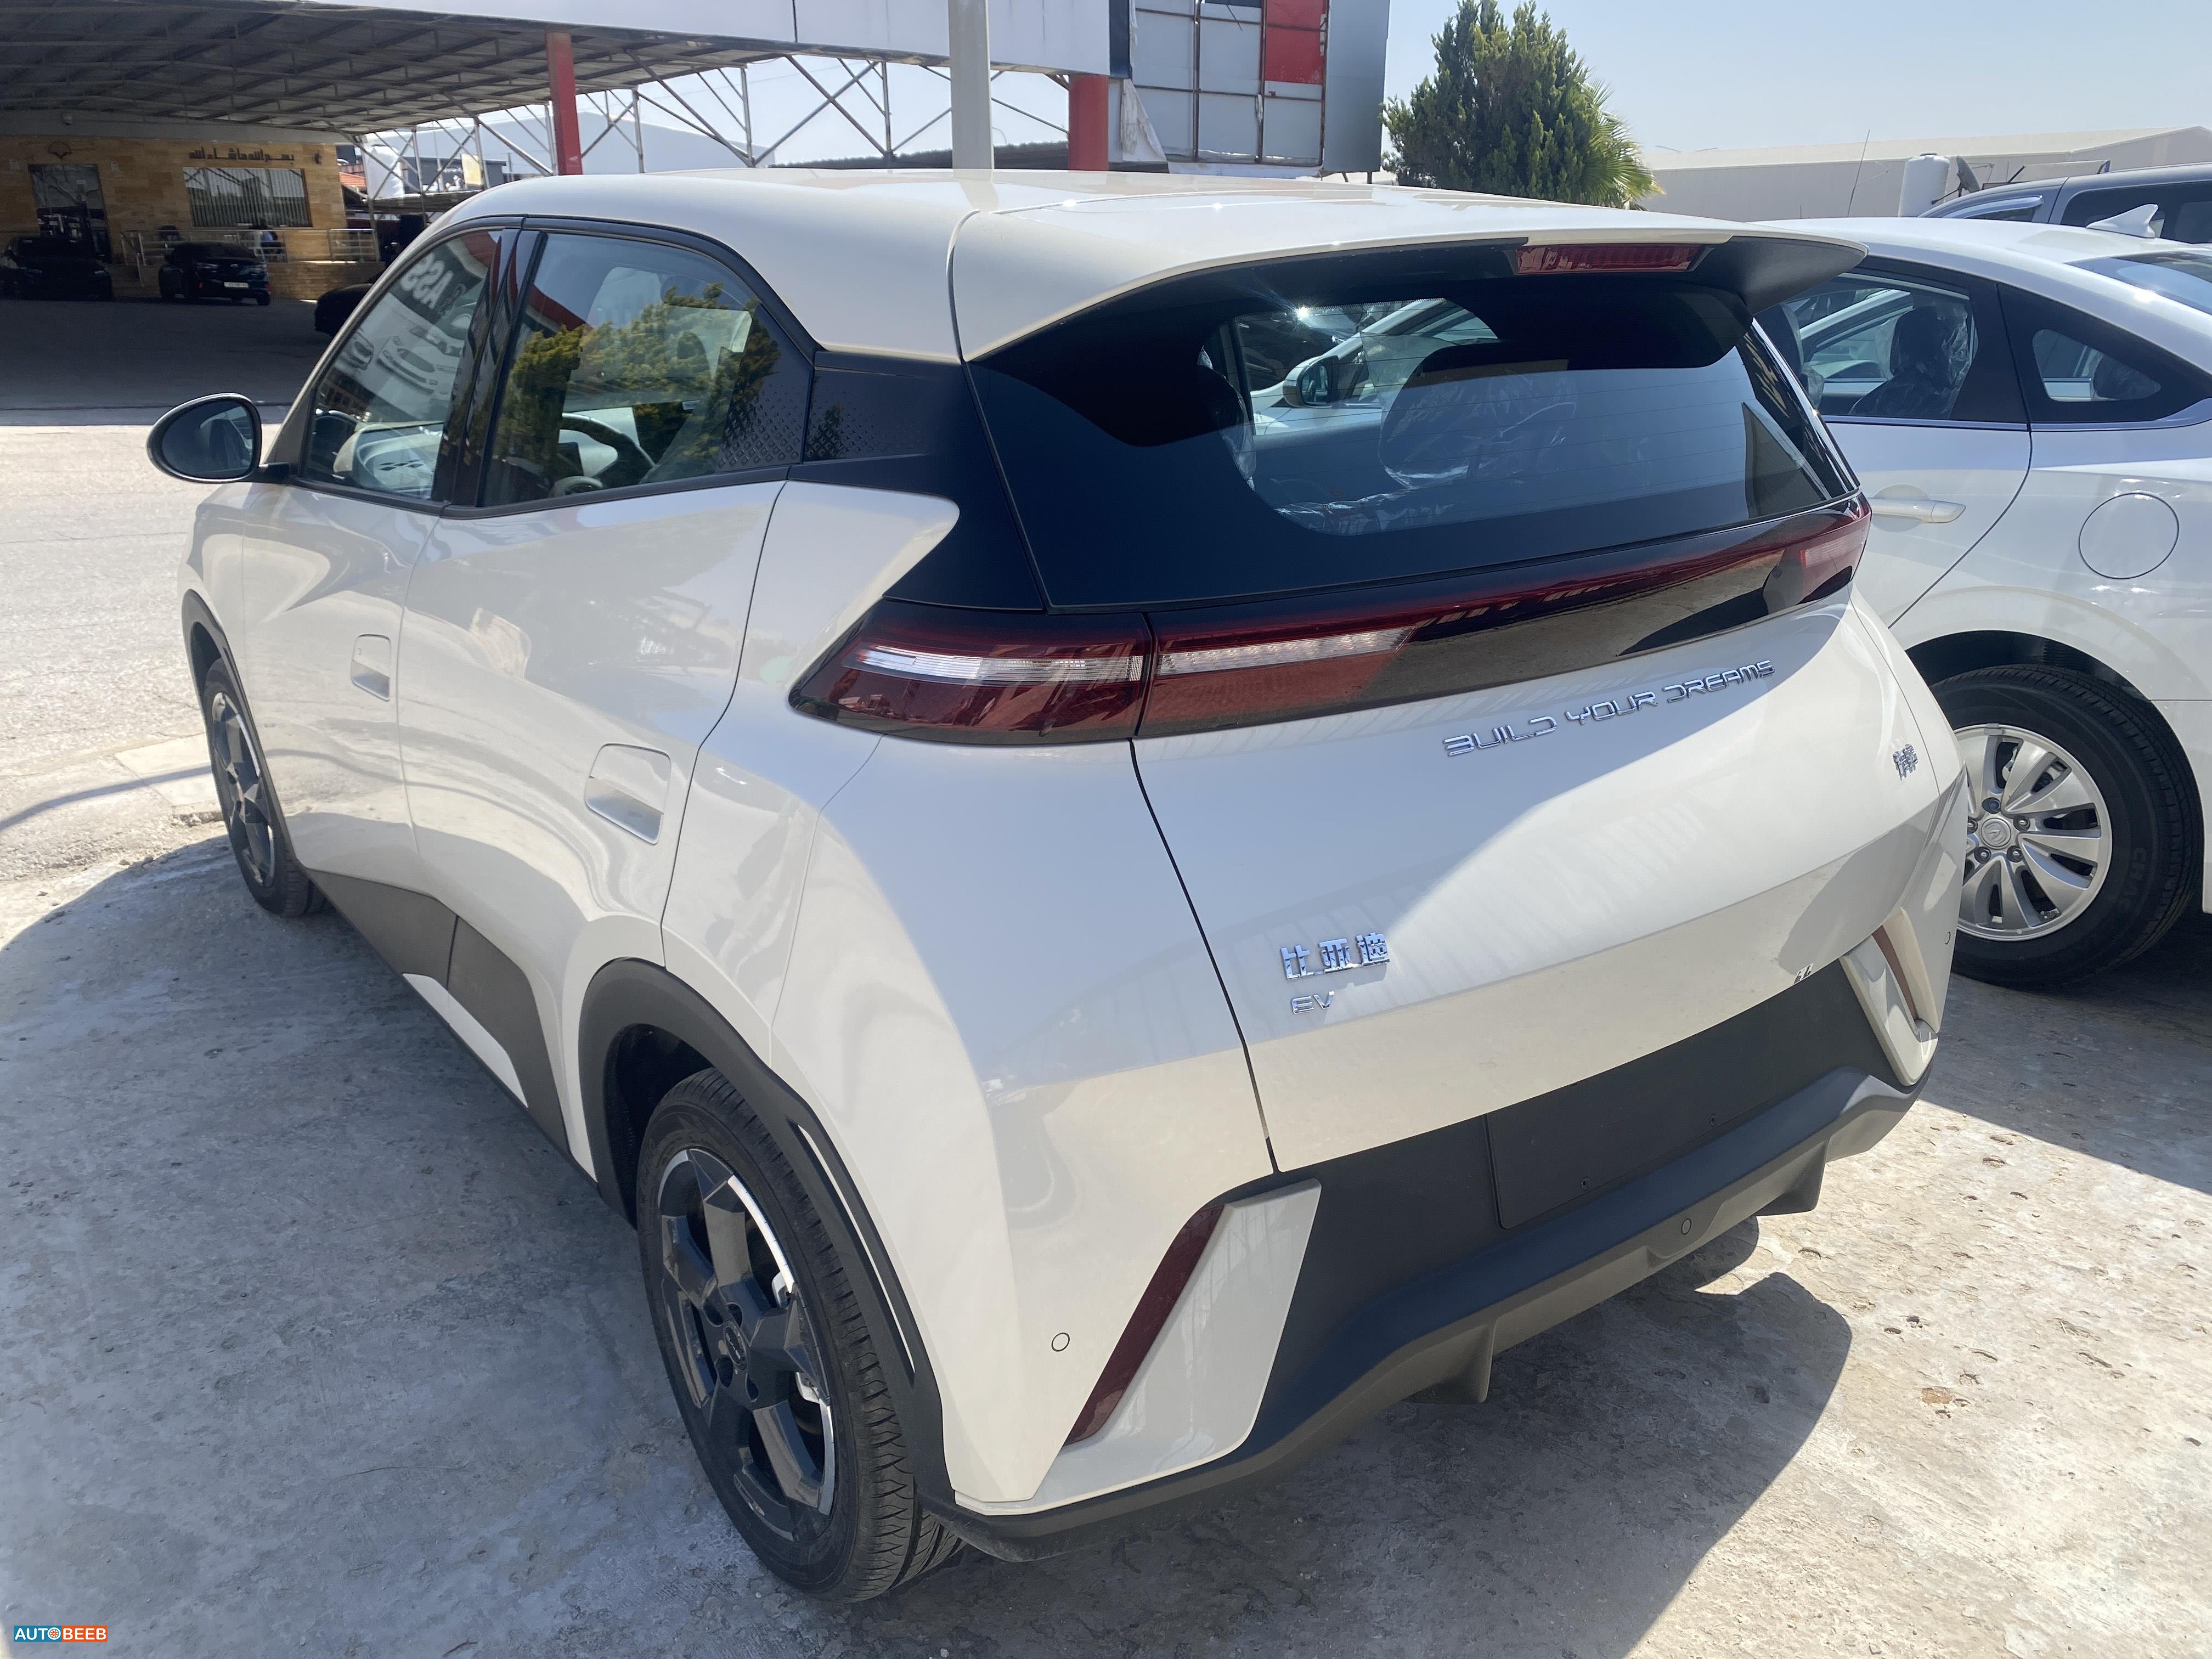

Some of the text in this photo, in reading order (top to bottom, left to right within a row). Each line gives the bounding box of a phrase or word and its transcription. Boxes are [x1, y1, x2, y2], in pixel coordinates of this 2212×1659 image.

[1443, 659, 1776, 757] BUILD YOUR DREAMS
[1280, 932, 1390, 980] 比亚迪
[1291, 991, 1335, 1014] EV
